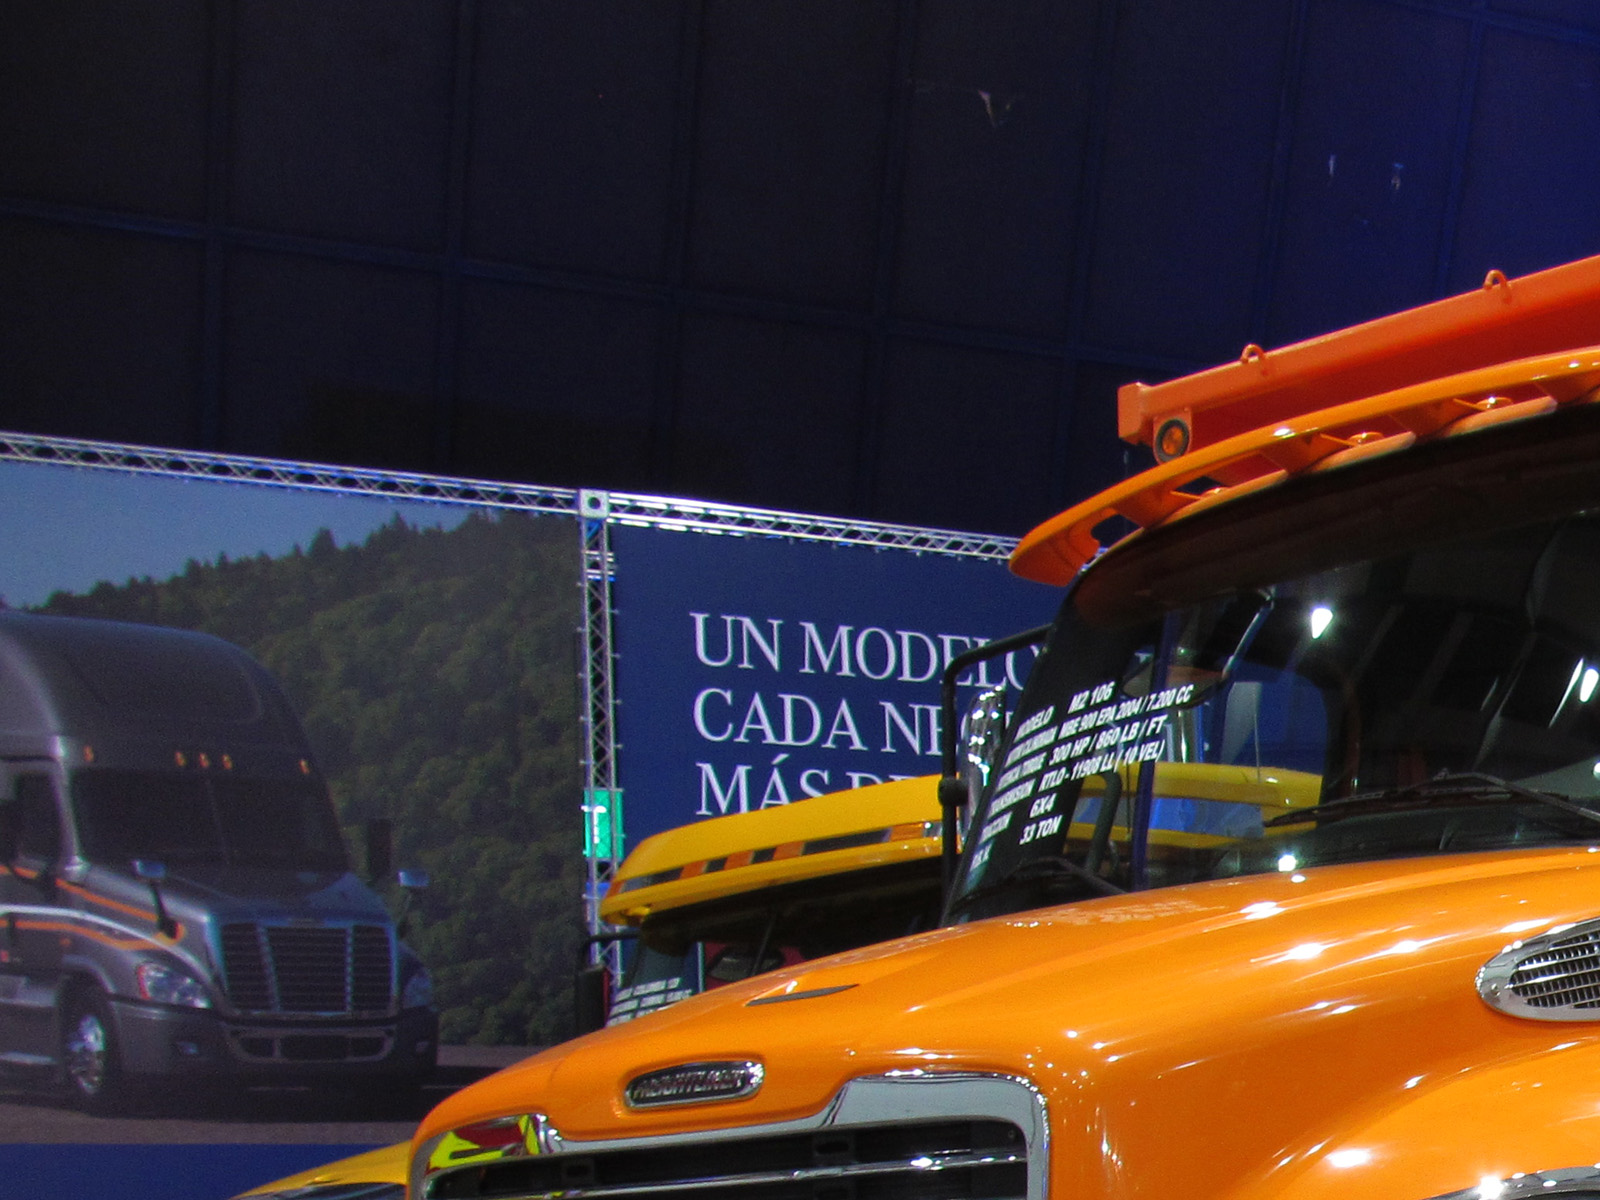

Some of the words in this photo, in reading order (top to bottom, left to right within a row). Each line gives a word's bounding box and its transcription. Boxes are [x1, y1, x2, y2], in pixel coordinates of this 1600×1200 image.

[689, 611, 783, 671] UN
[1090, 681, 1116, 706] 106
[1175, 684, 1194, 705] CC
[693, 687, 867, 750] CADA
[1048, 742, 1073, 766] 300
[1070, 735, 1092, 759] HP
[1120, 721, 1141, 743] LB
[1145, 714, 1168, 737] FT
[1029, 793, 1057, 818] 6X4
[1019, 823, 1037, 845] 33
[1035, 814, 1063, 839] TON
